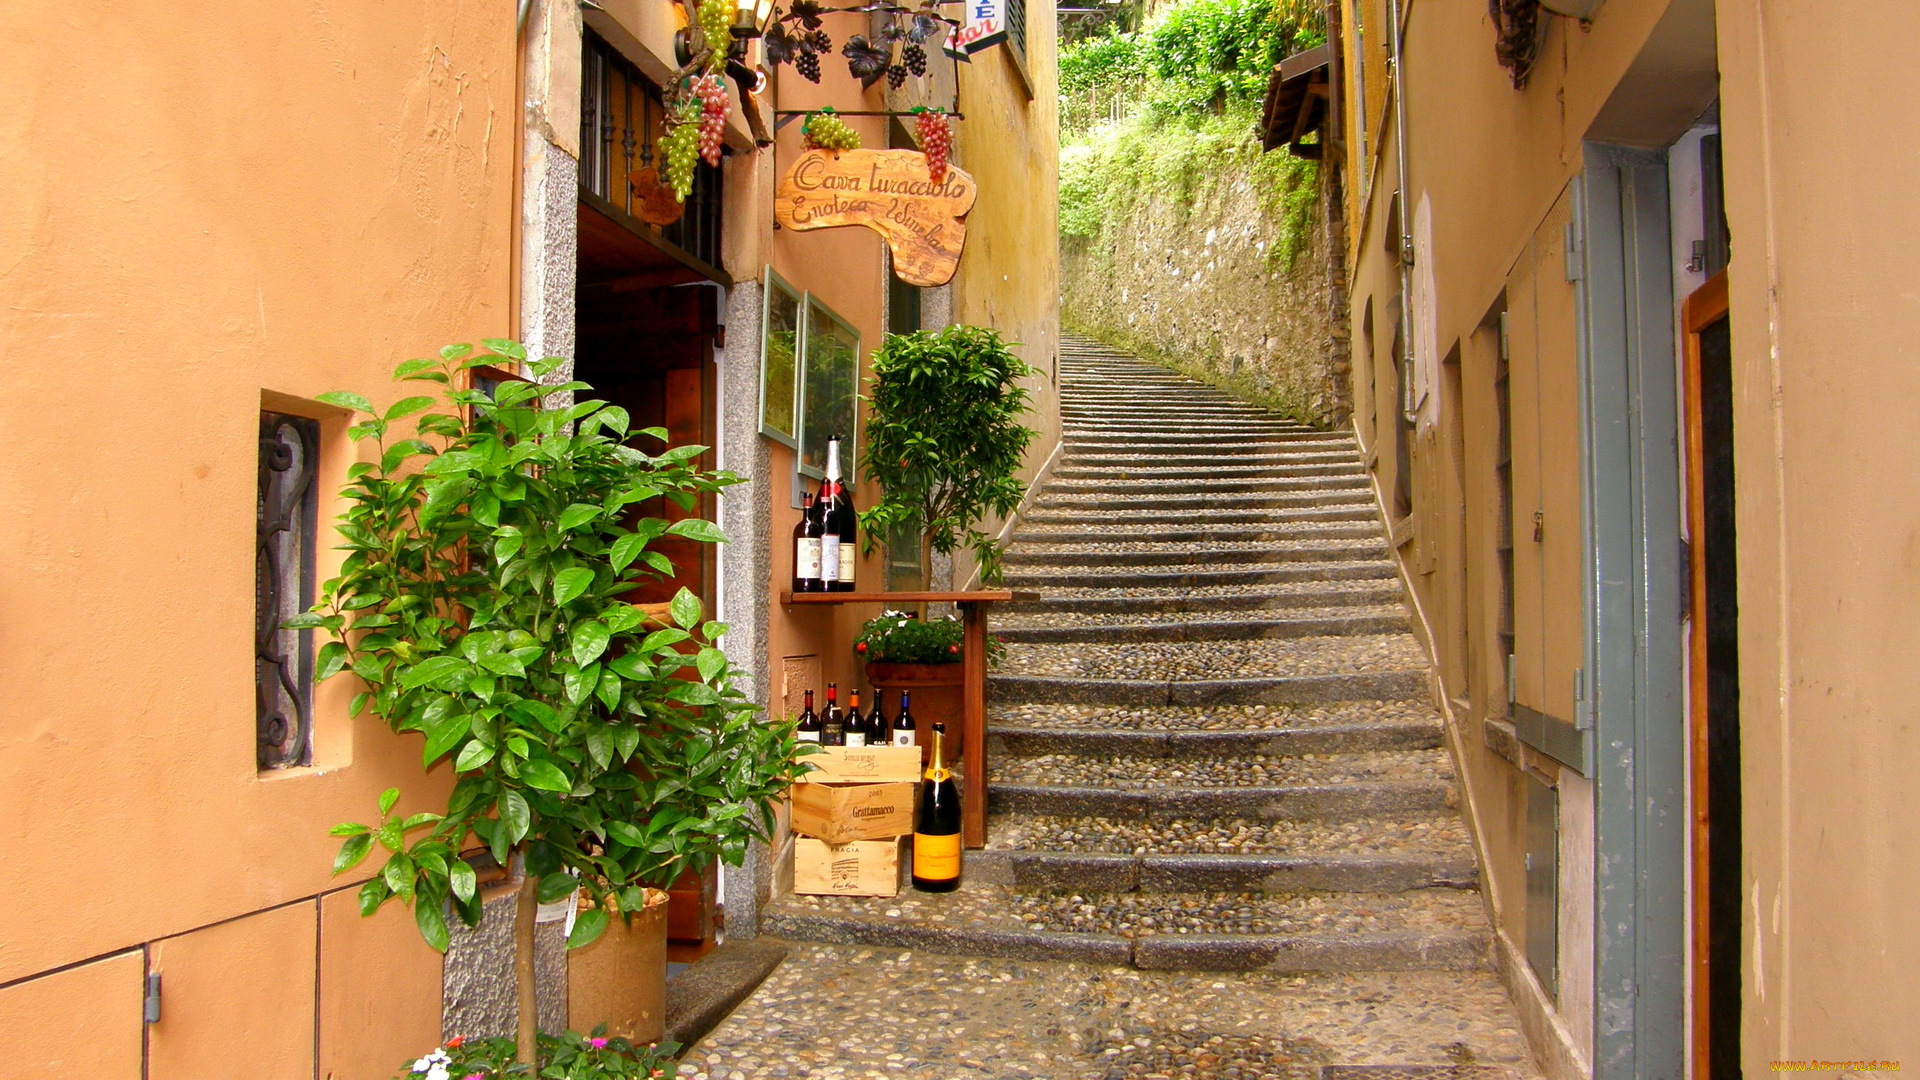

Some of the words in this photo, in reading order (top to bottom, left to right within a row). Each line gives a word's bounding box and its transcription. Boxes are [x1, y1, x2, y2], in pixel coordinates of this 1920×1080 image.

[793, 154, 862, 192] Cava
[791, 194, 870, 224] Enoteca
[852, 805, 895, 818] Grattamacco
